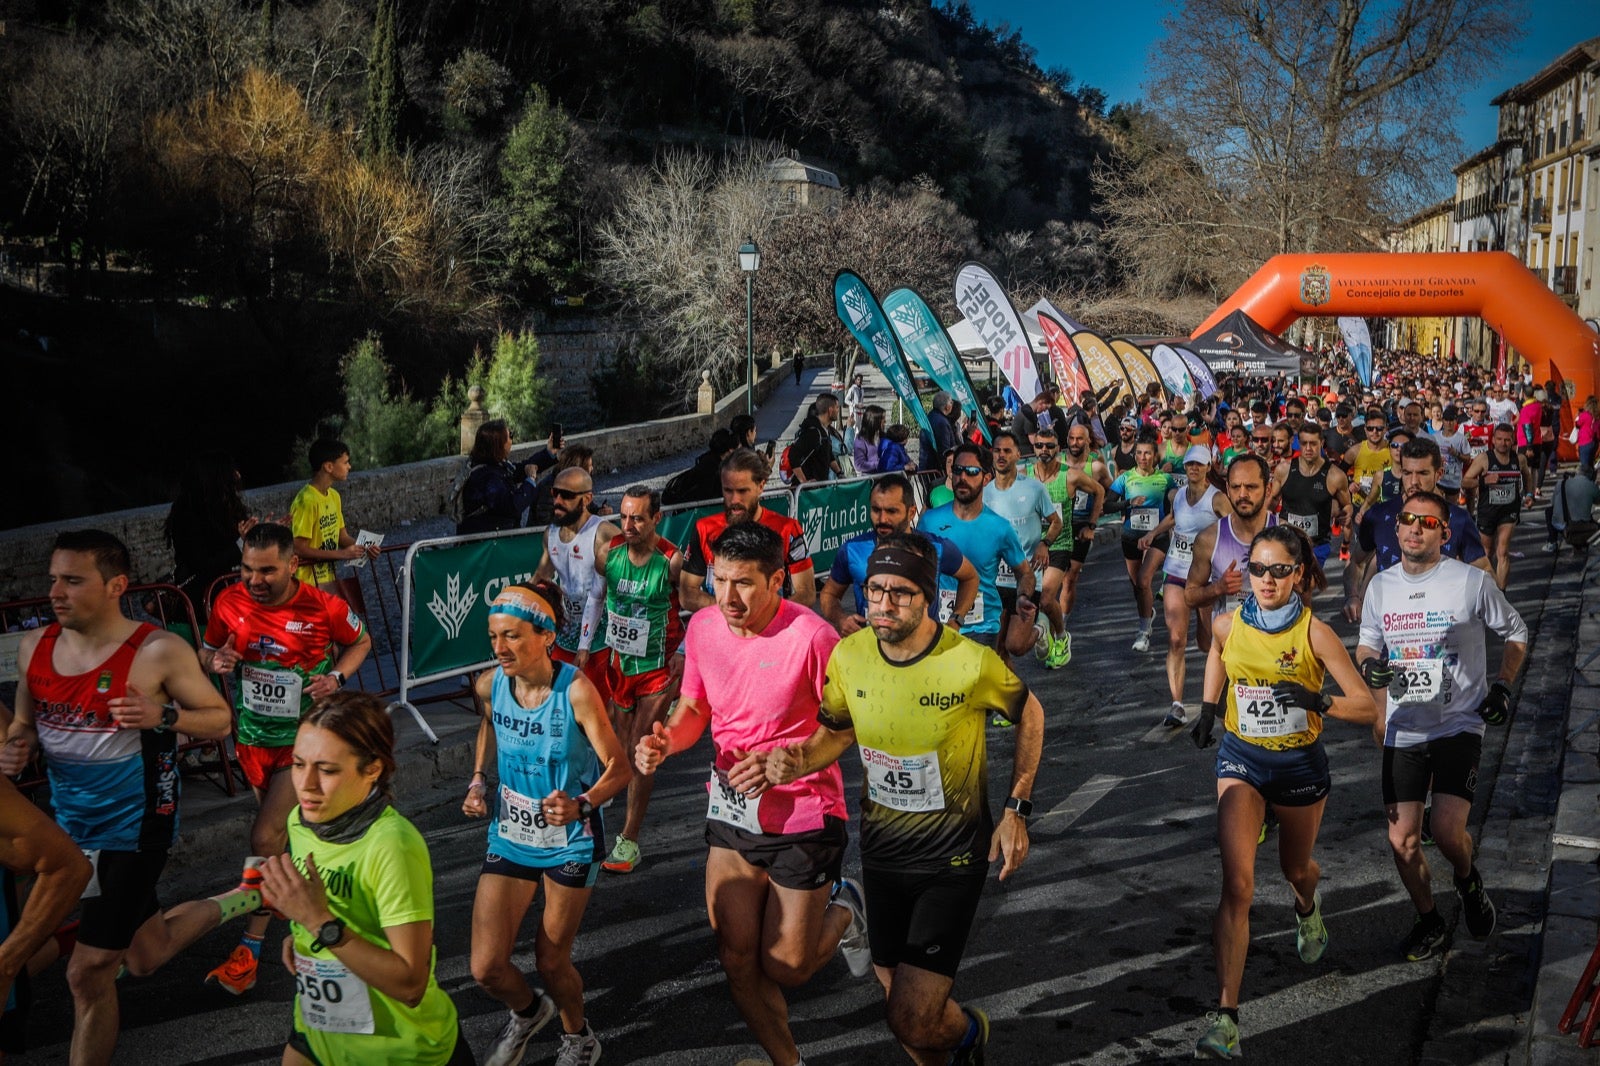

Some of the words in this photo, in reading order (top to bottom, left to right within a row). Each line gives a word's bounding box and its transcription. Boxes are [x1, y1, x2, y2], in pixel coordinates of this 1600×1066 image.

[1428, 276, 1476, 286] GRANADA
[1404, 288, 1416, 297] de
[1420, 288, 1464, 298] Deportes
[1140, 514, 1150, 522] 91
[822, 535, 839, 552] CAJA
[1384, 613, 1392, 632] 9
[1392, 612, 1424, 622] Carrera
[1391, 620, 1426, 632] Solidaria
[611, 623, 638, 641] 358
[244, 667, 250, 678] 9
[1398, 672, 1432, 688] 323
[252, 682, 286, 698] 300
[1238, 686, 1244, 698] 9
[920, 692, 966, 711] alight
[1246, 700, 1289, 718] 421
[493, 710, 544, 738] nerja
[863, 748, 872, 762] 9
[872, 750, 900, 764] Carrera
[872, 758, 902, 770] Solidaria
[884, 770, 913, 788] 45
[504, 788, 509, 800] 9
[508, 794, 530, 804] Carrera
[510, 805, 548, 829] 596
